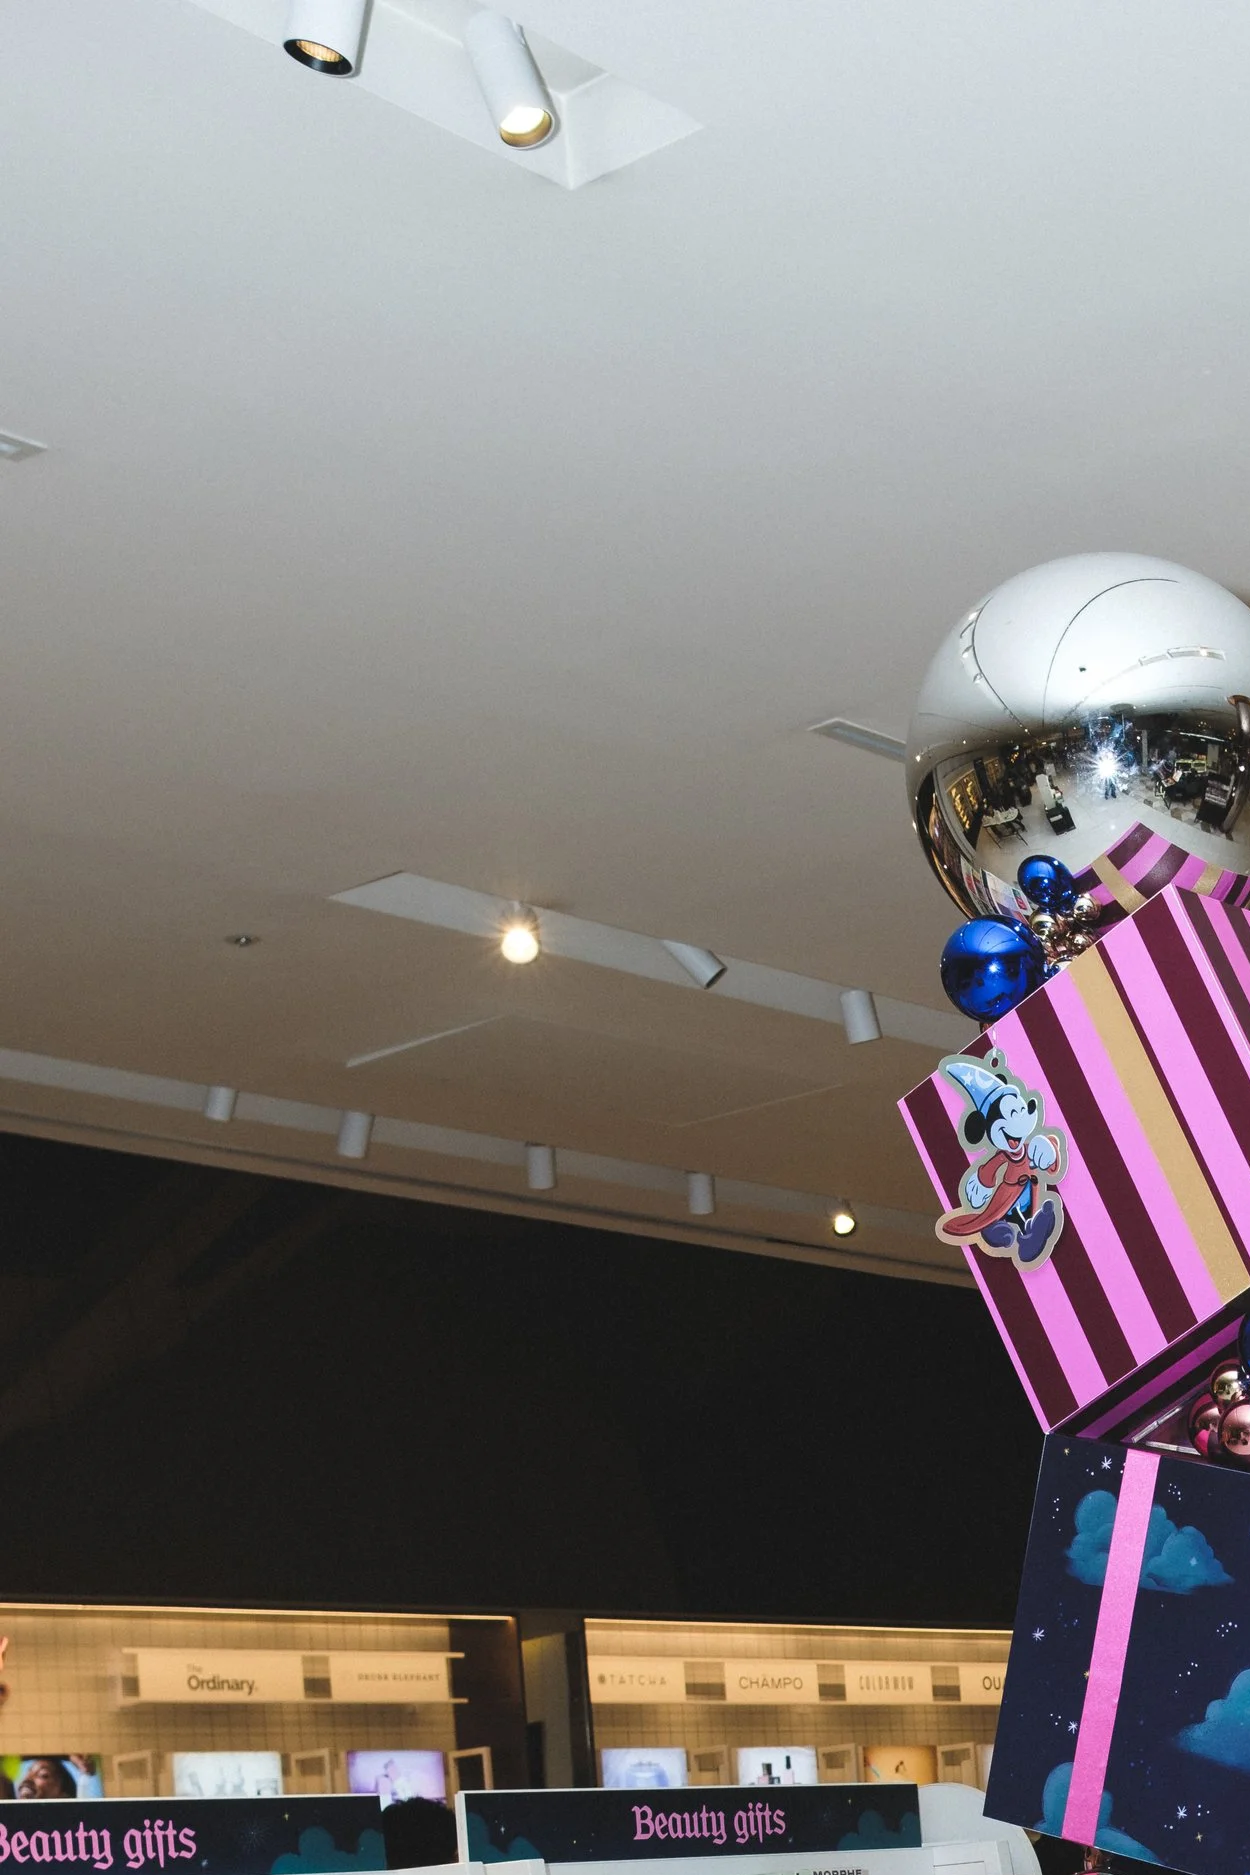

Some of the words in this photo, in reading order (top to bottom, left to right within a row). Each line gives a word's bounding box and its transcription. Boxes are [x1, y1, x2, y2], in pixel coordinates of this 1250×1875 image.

[983, 1676, 1004, 1690] OU
[123, 1818, 197, 1868] gifts
[632, 1804, 727, 1846] Beauty
[734, 1802, 786, 1844] gifts
